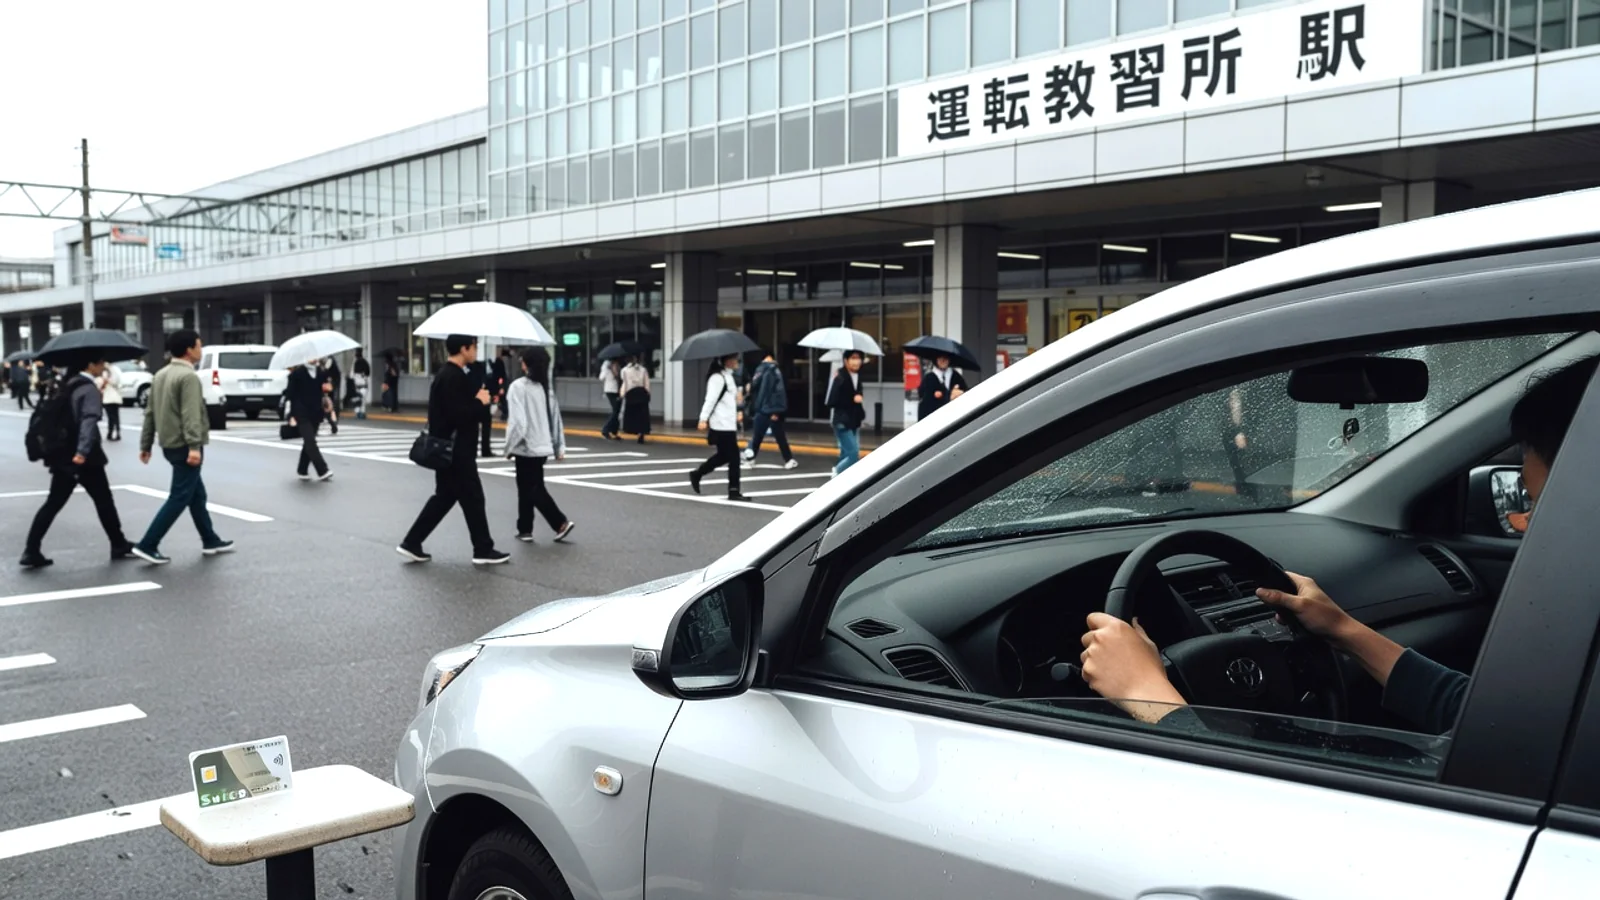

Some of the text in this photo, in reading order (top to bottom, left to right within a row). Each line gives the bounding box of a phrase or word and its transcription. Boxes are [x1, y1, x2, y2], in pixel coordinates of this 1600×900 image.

[927, 4, 1366, 144] 運転教習所 駅
